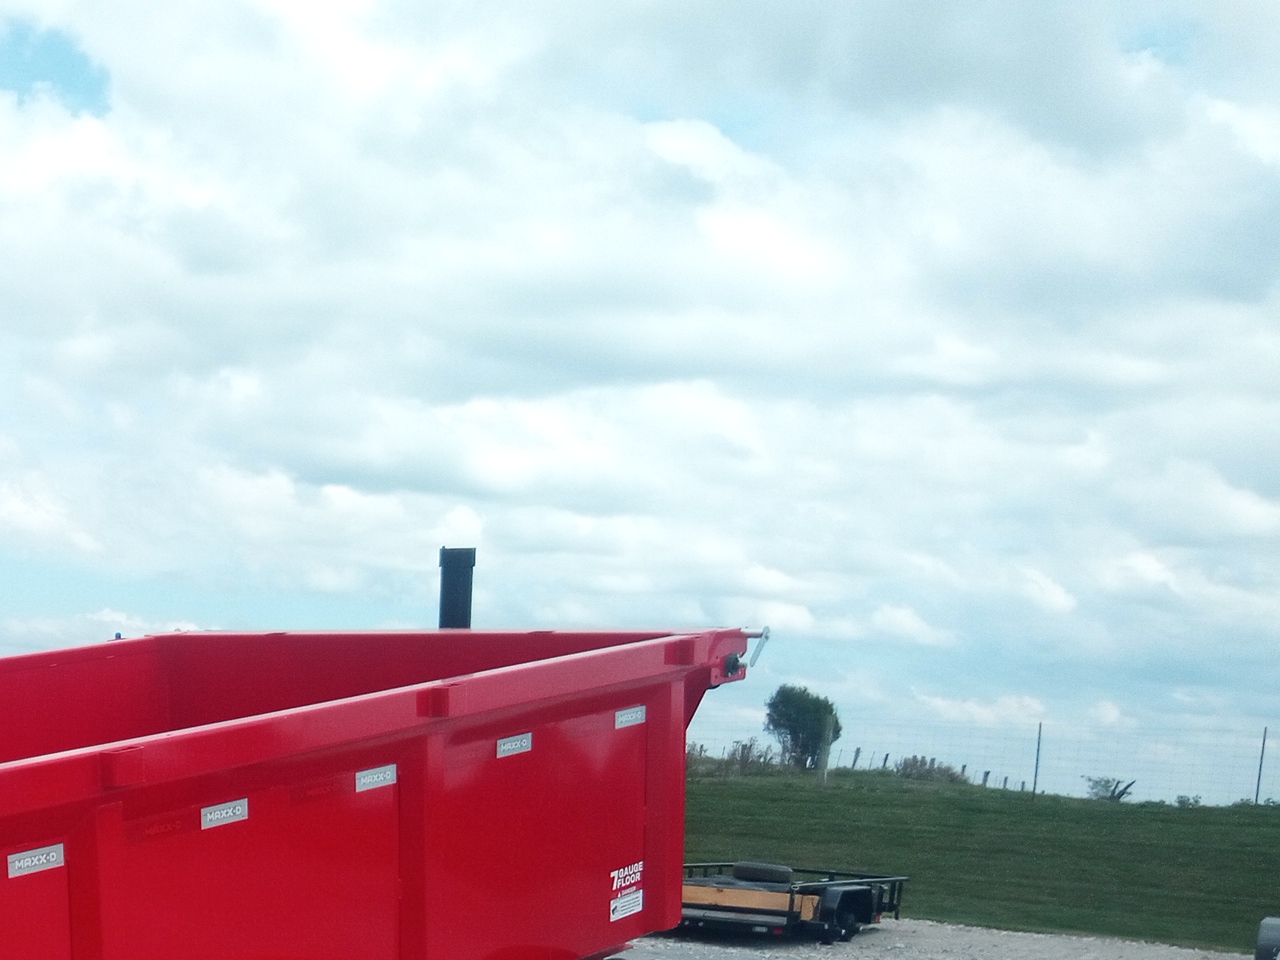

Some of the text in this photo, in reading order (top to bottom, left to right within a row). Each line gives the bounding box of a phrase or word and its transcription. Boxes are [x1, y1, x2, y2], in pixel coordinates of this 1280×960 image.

[610, 861, 644, 891] 7 GAUGE
[617, 872, 641, 889] FLOOR
